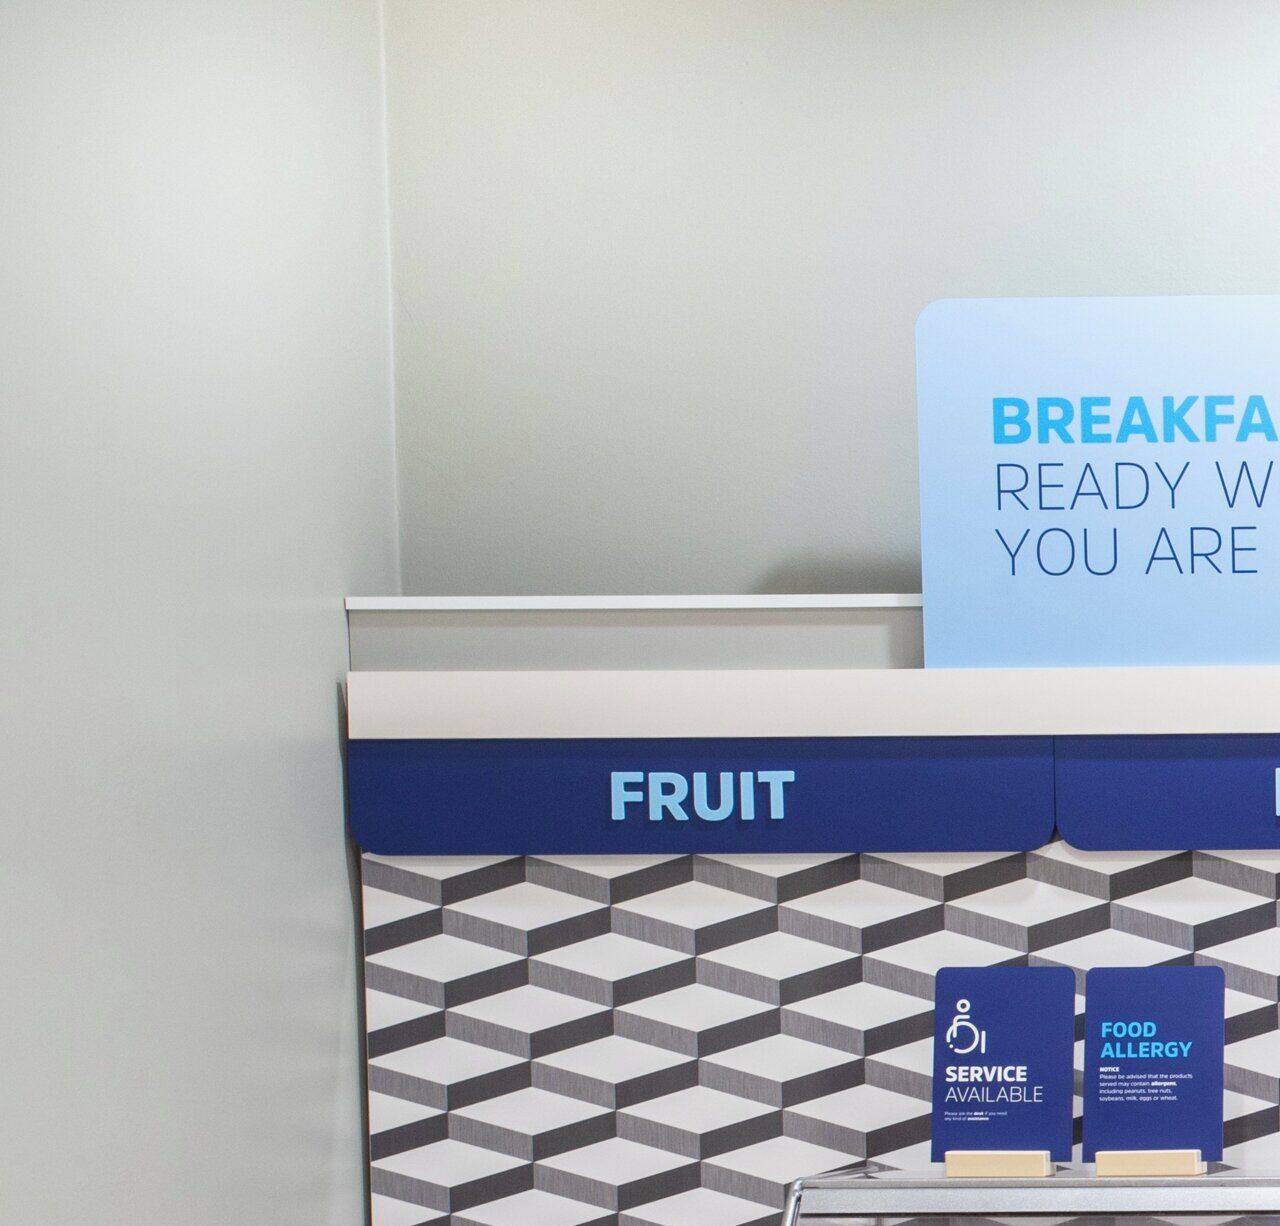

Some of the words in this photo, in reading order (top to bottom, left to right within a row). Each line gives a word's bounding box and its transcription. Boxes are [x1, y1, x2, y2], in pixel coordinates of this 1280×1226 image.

[996, 461, 1191, 511] READY
[994, 528, 1119, 577] YOU
[1144, 526, 1259, 575] ARE
[610, 770, 795, 821] FRUIT
[1100, 1021, 1157, 1038] FOOD
[1100, 1041, 1193, 1059] ALLERGY
[944, 1065, 1028, 1083] SERVICE
[944, 1085, 1044, 1103] AVAILABLE
